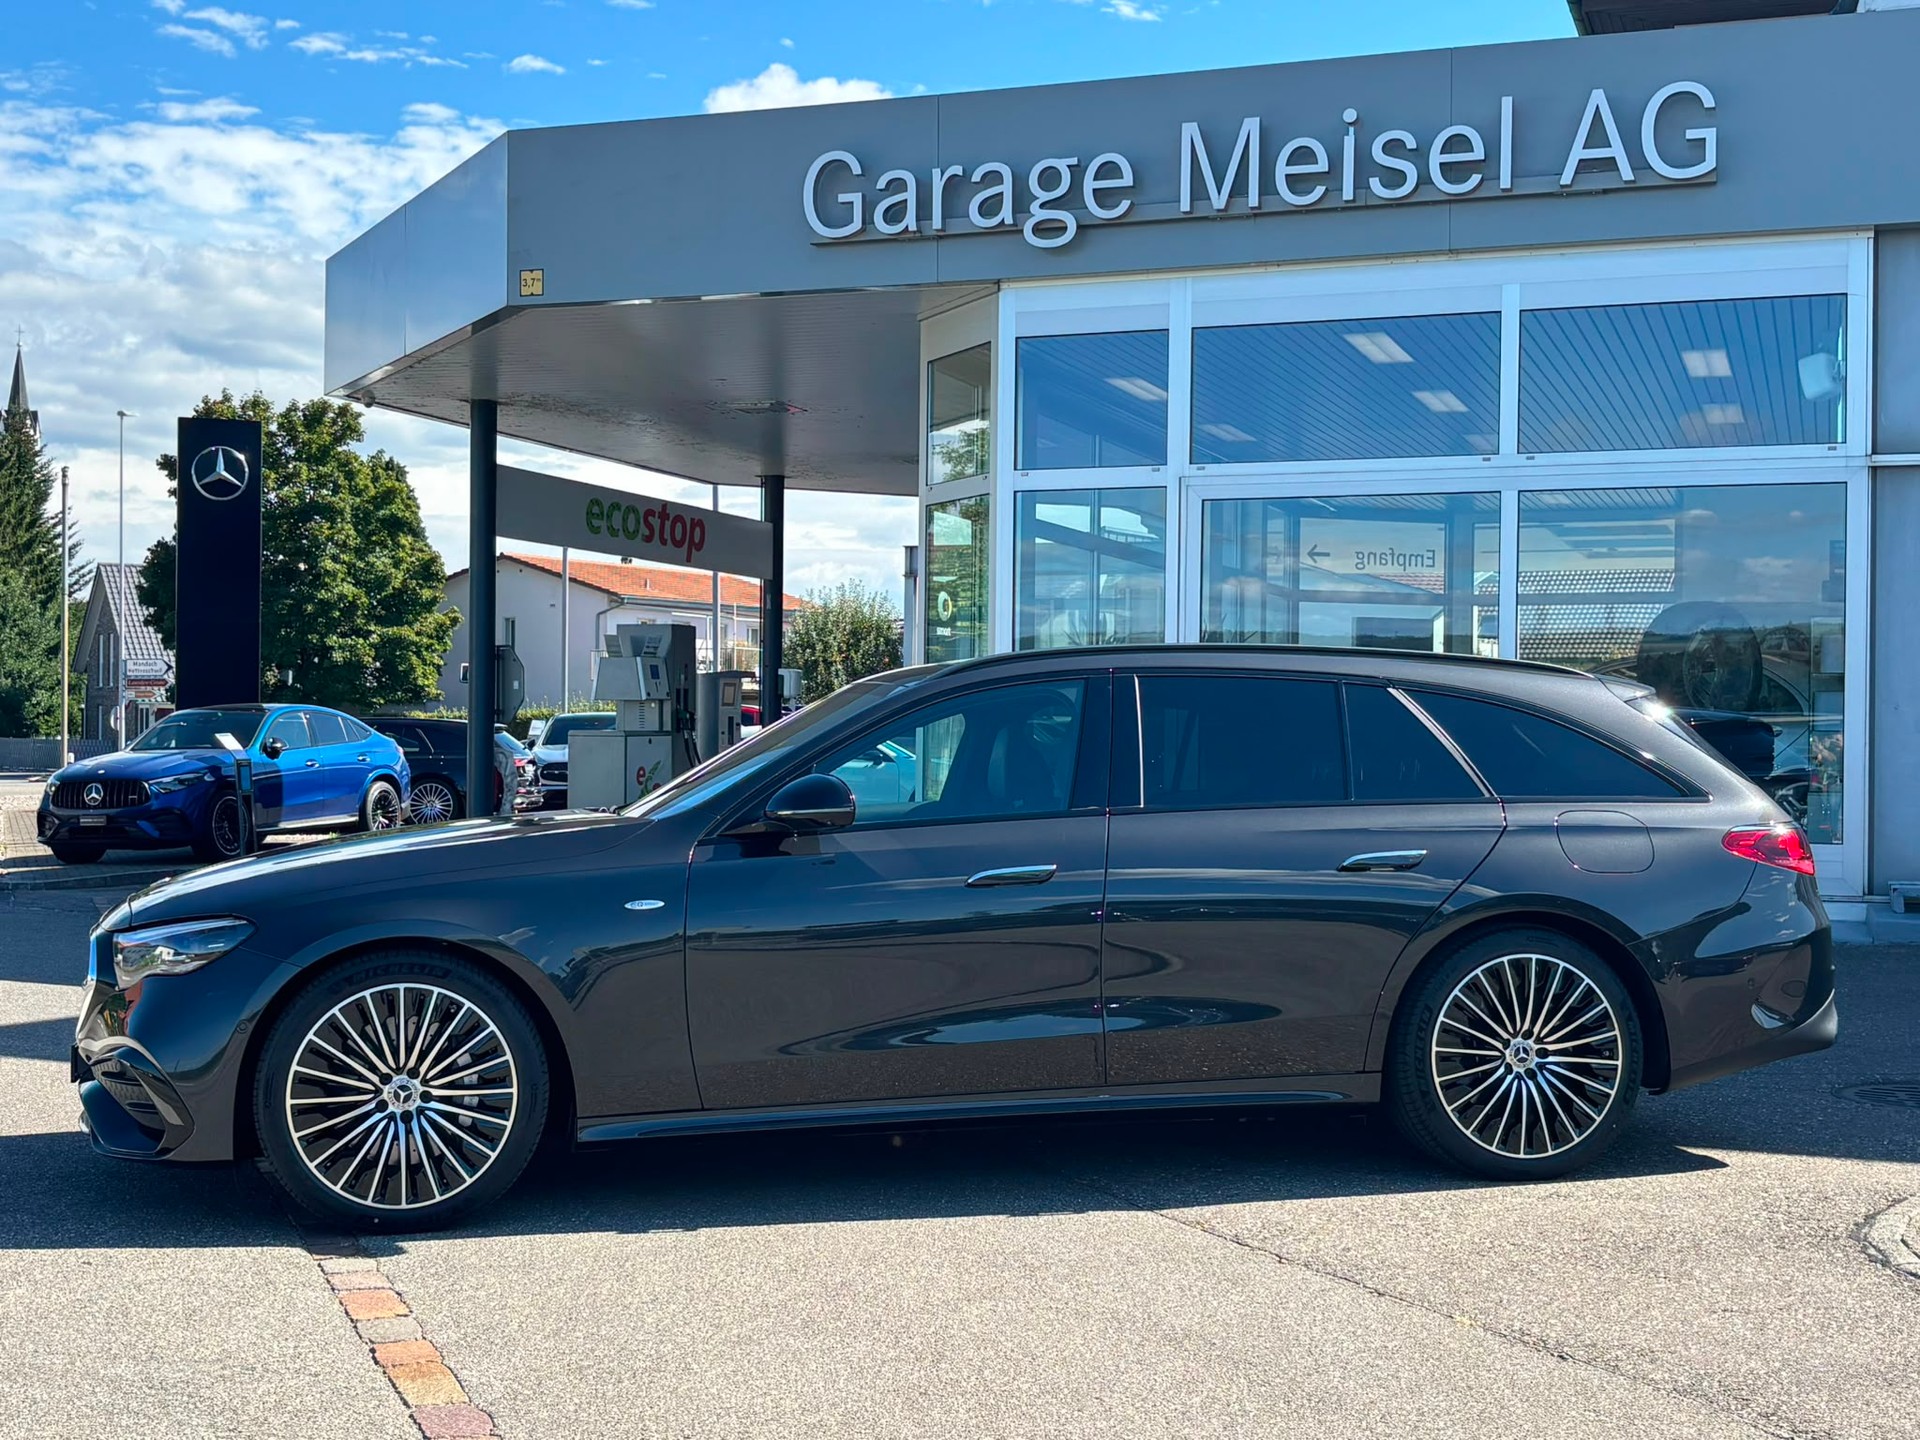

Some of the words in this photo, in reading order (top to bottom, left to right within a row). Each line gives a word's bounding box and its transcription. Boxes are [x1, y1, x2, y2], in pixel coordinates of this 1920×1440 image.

[802, 150, 1134, 248] Garage
[1180, 96, 1513, 213] Meisel
[1559, 81, 1717, 185] AG
[586, 498, 705, 563] ecostop
